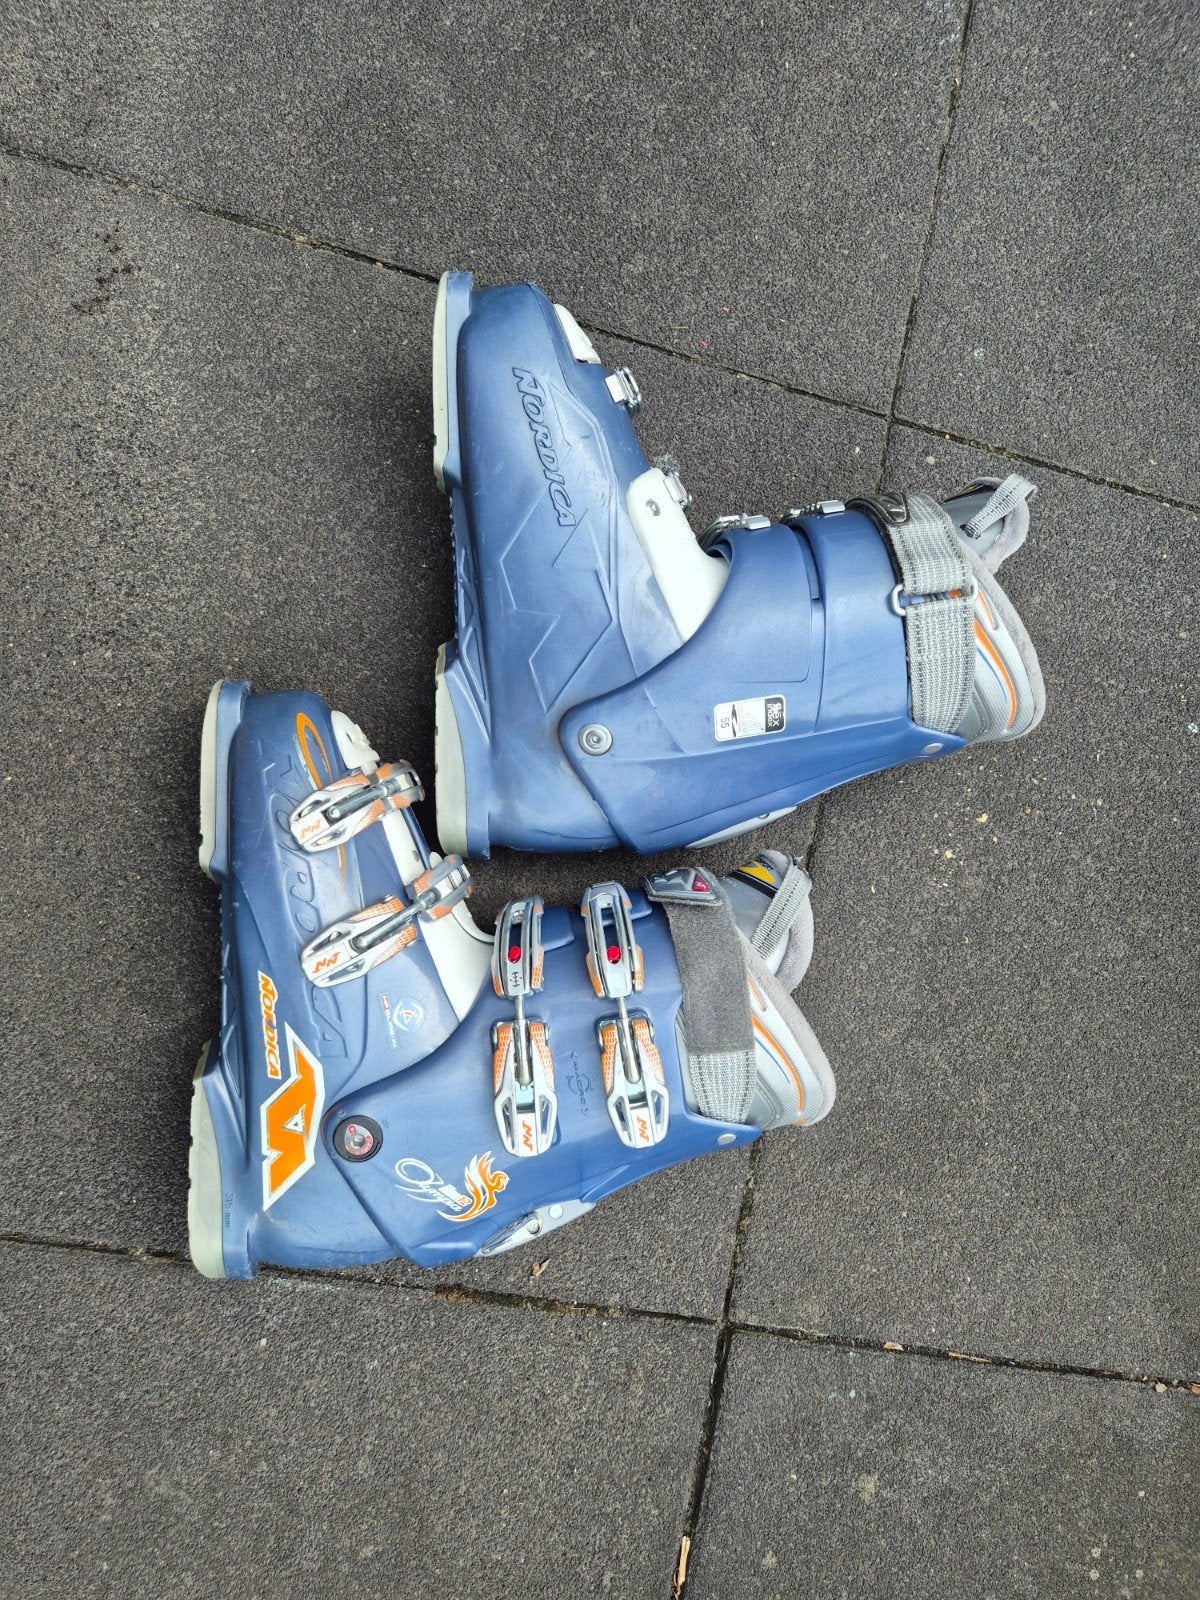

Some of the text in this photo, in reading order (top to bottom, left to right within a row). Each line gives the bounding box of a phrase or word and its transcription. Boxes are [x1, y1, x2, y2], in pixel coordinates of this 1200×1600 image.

[512, 366, 577, 527] NORDICA
[720, 717, 730, 729] 55
[259, 972, 281, 1078] NORDICA
